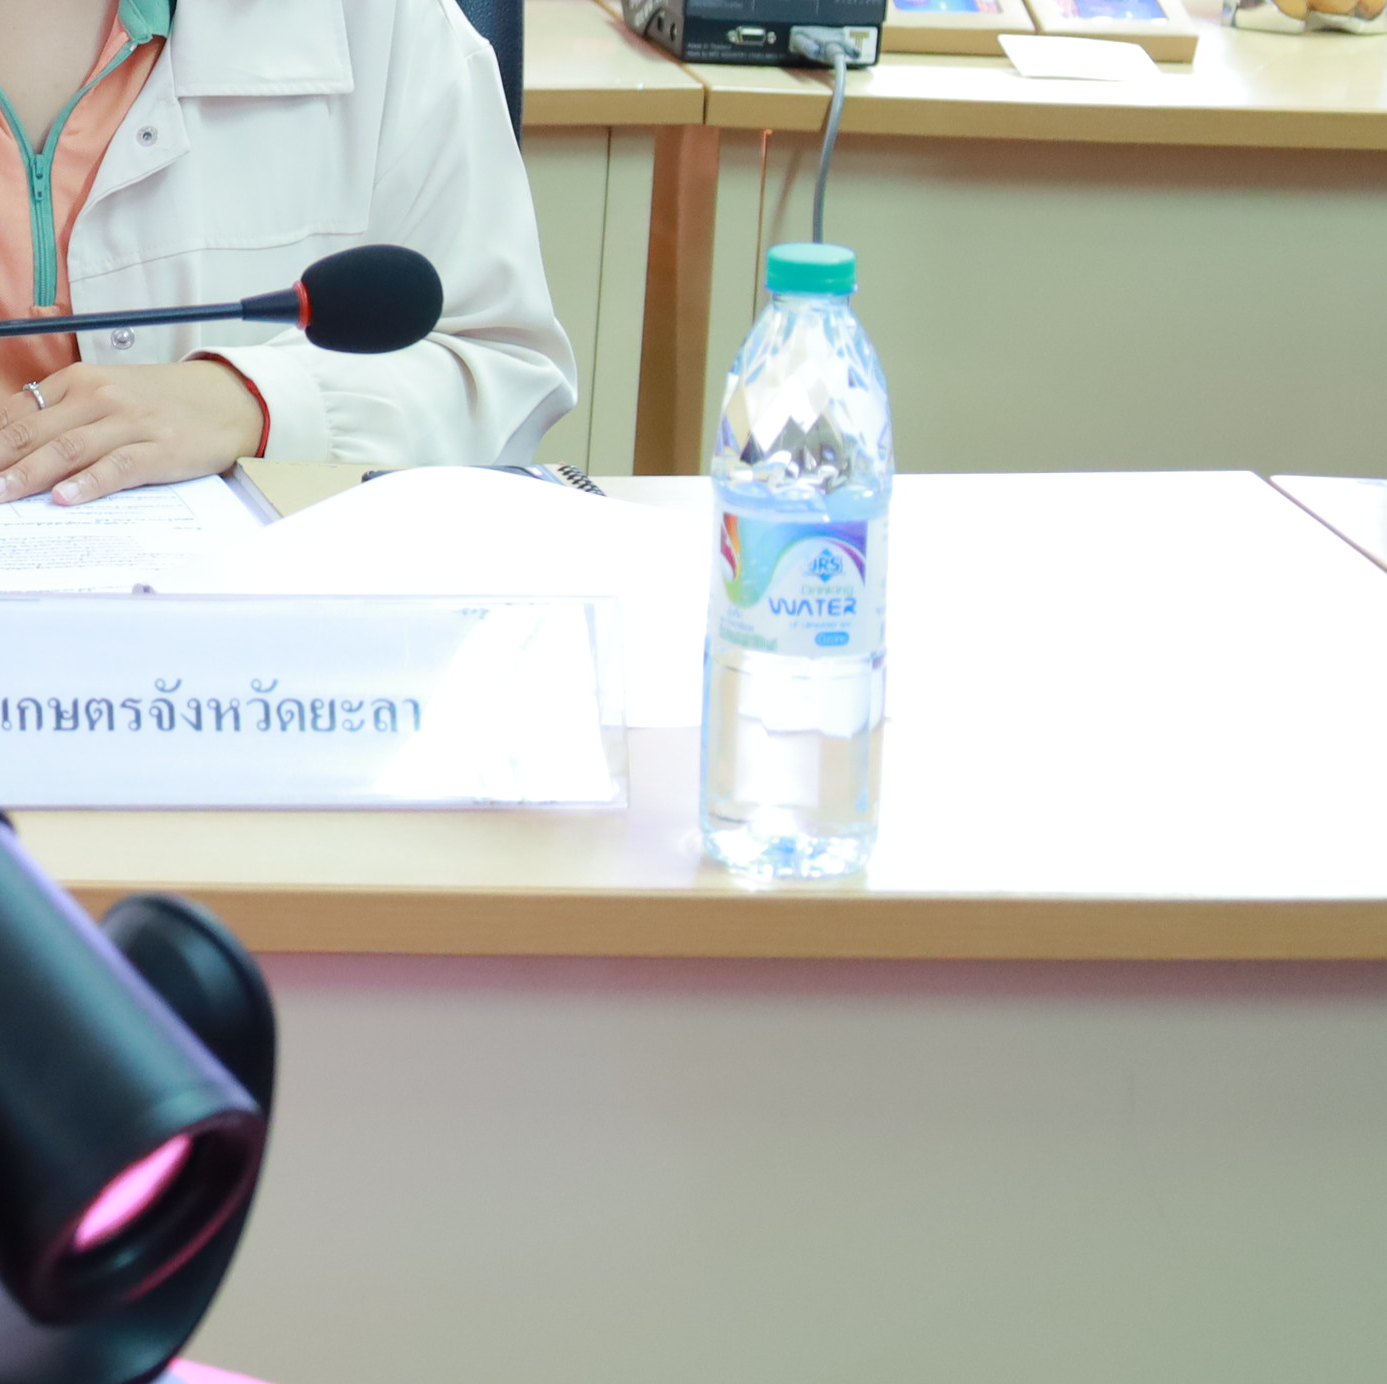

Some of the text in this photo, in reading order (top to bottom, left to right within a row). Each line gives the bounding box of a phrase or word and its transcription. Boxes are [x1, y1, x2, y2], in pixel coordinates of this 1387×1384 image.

[769, 597, 857, 617] WATER
[0, 679, 420, 734] เกษตรจังหวัดยะลา
